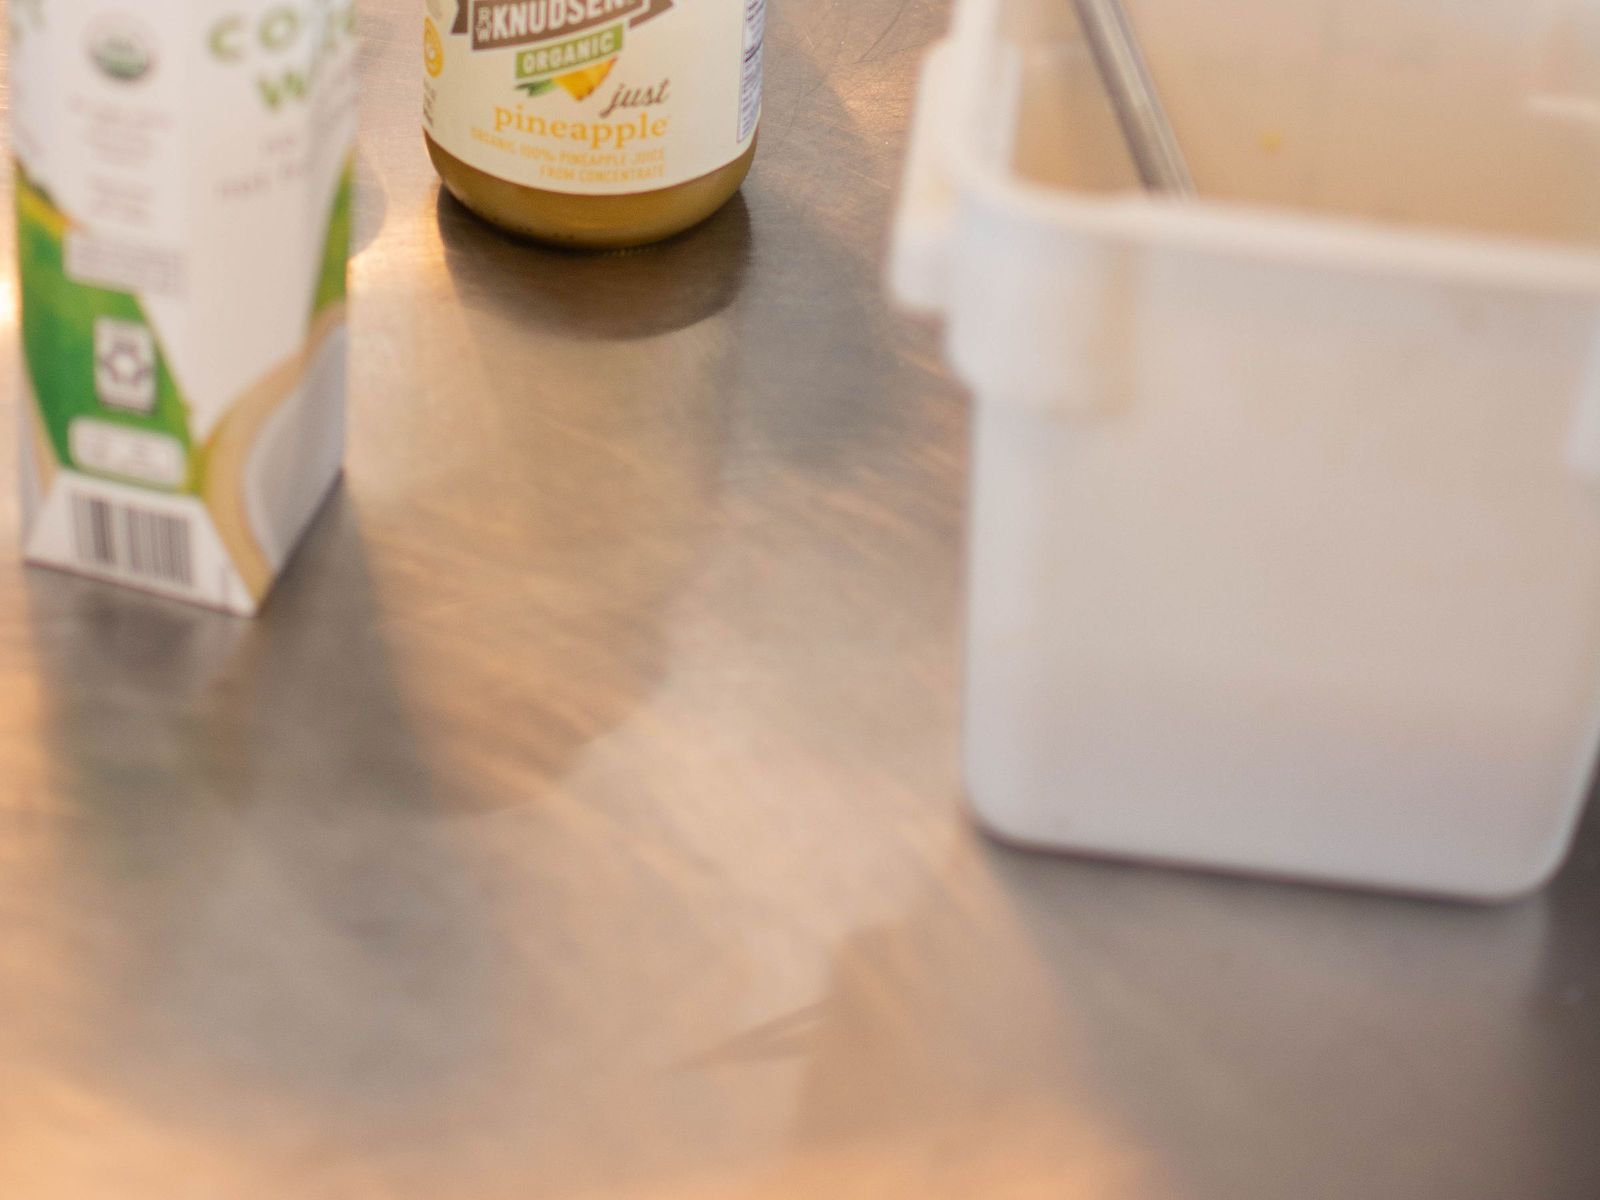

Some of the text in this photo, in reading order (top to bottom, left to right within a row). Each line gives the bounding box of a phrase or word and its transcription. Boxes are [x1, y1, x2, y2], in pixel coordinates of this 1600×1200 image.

[522, 31, 615, 74] ORGANIC
[599, 77, 670, 119] just
[494, 103, 668, 149] pineapple
[540, 164, 666, 182] FROM CONCENTRATE
[559, 150, 626, 166] PINEAPPLE
[635, 148, 666, 162] JUICE
